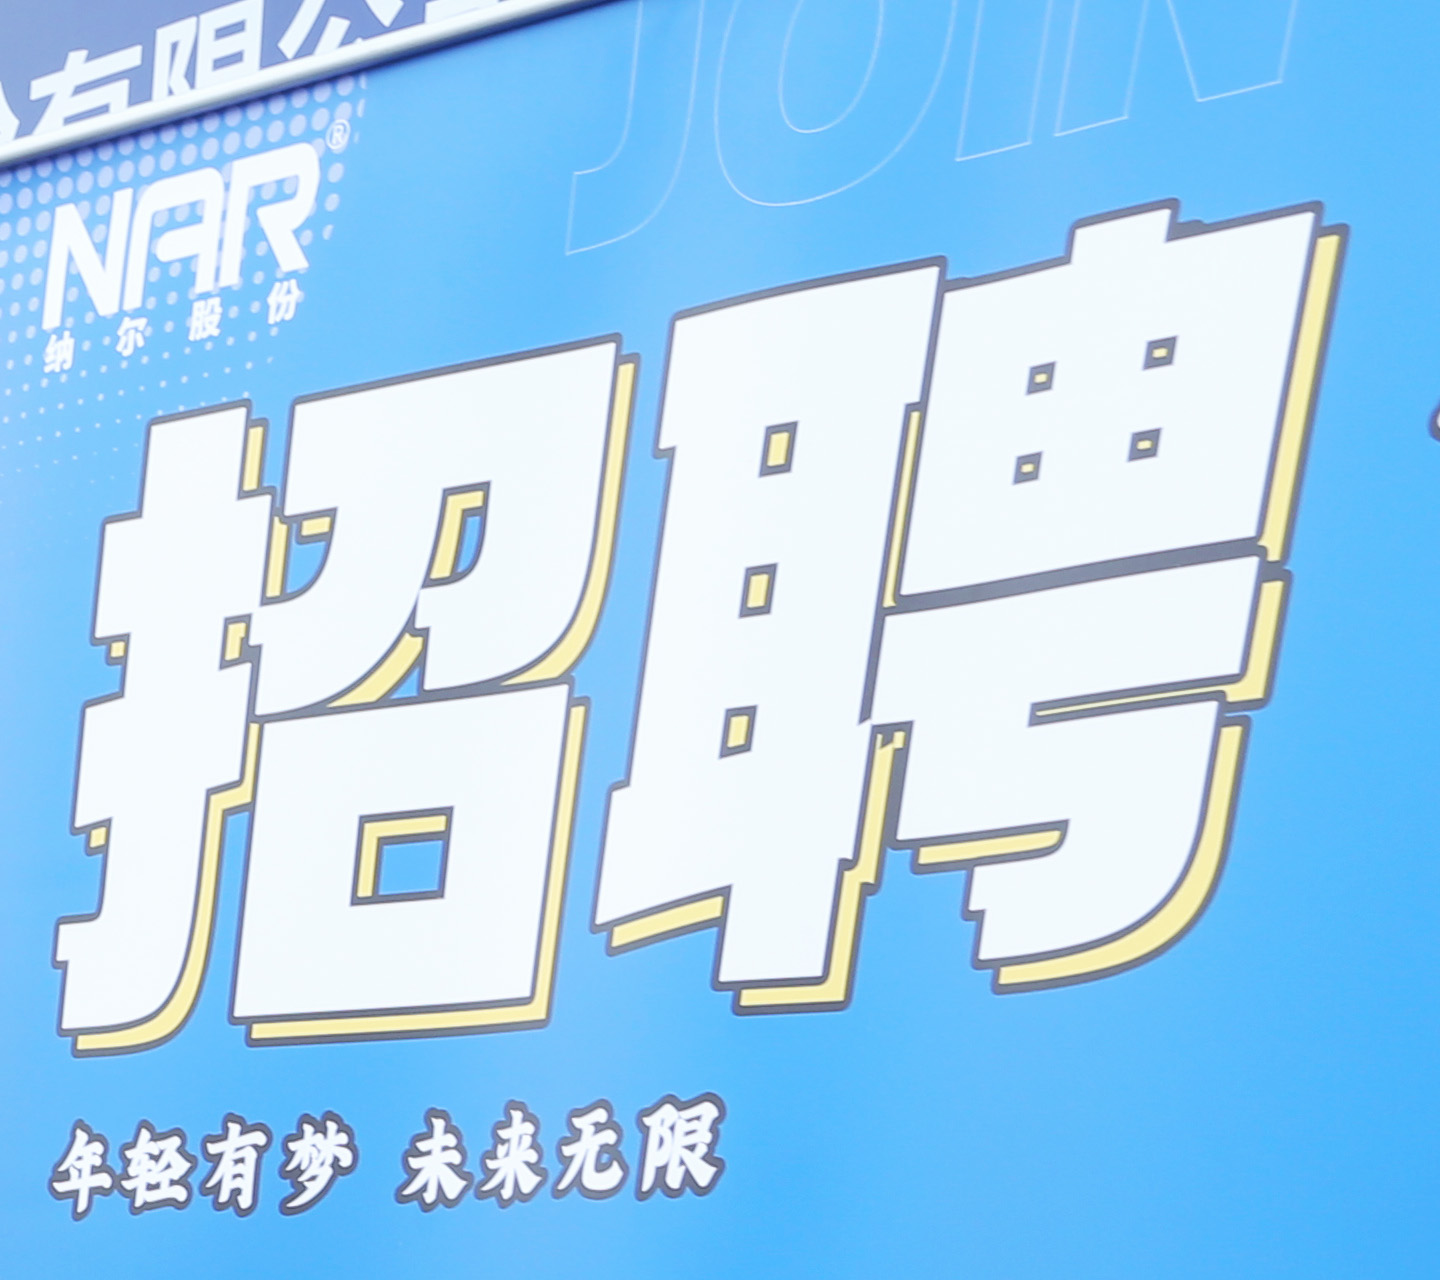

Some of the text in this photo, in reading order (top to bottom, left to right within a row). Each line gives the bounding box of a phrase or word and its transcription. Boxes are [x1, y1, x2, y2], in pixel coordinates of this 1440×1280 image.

[42, 141, 320, 332] NAR
[42, 275, 305, 376] 纳尔股份
[54, 199, 1349, 1057] 招聘
[51, 1091, 727, 1220] 年轻有梦 未来无限
